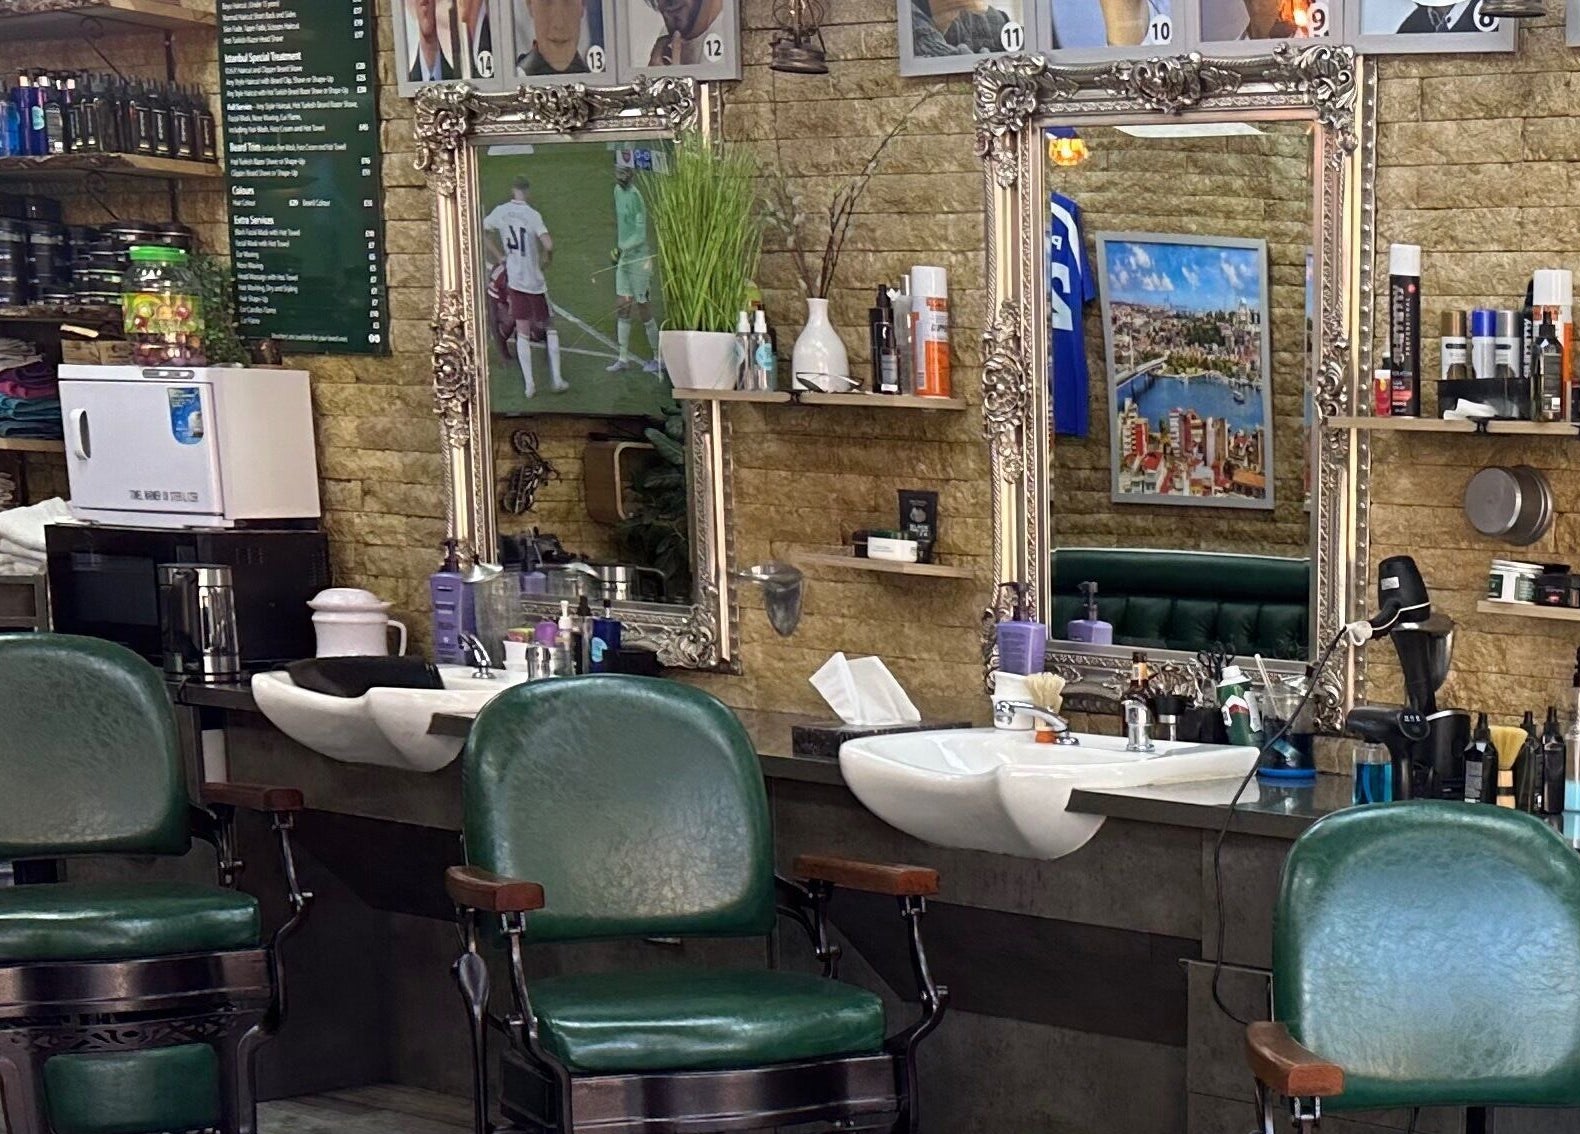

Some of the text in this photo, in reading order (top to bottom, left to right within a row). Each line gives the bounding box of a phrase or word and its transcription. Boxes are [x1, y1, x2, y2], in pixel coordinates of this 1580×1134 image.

[1312, 8, 1326, 31] 9
[1004, 27, 1020, 47] 11
[1151, 22, 1169, 41] 10
[249, 52, 270, 64] Special
[271, 51, 302, 61] Treatment
[706, 40, 722, 57] 12
[479, 56, 492, 76] 14
[589, 51, 603, 70] 13
[231, 185, 255, 195] Colours
[233, 215, 275, 225] Extra Services
